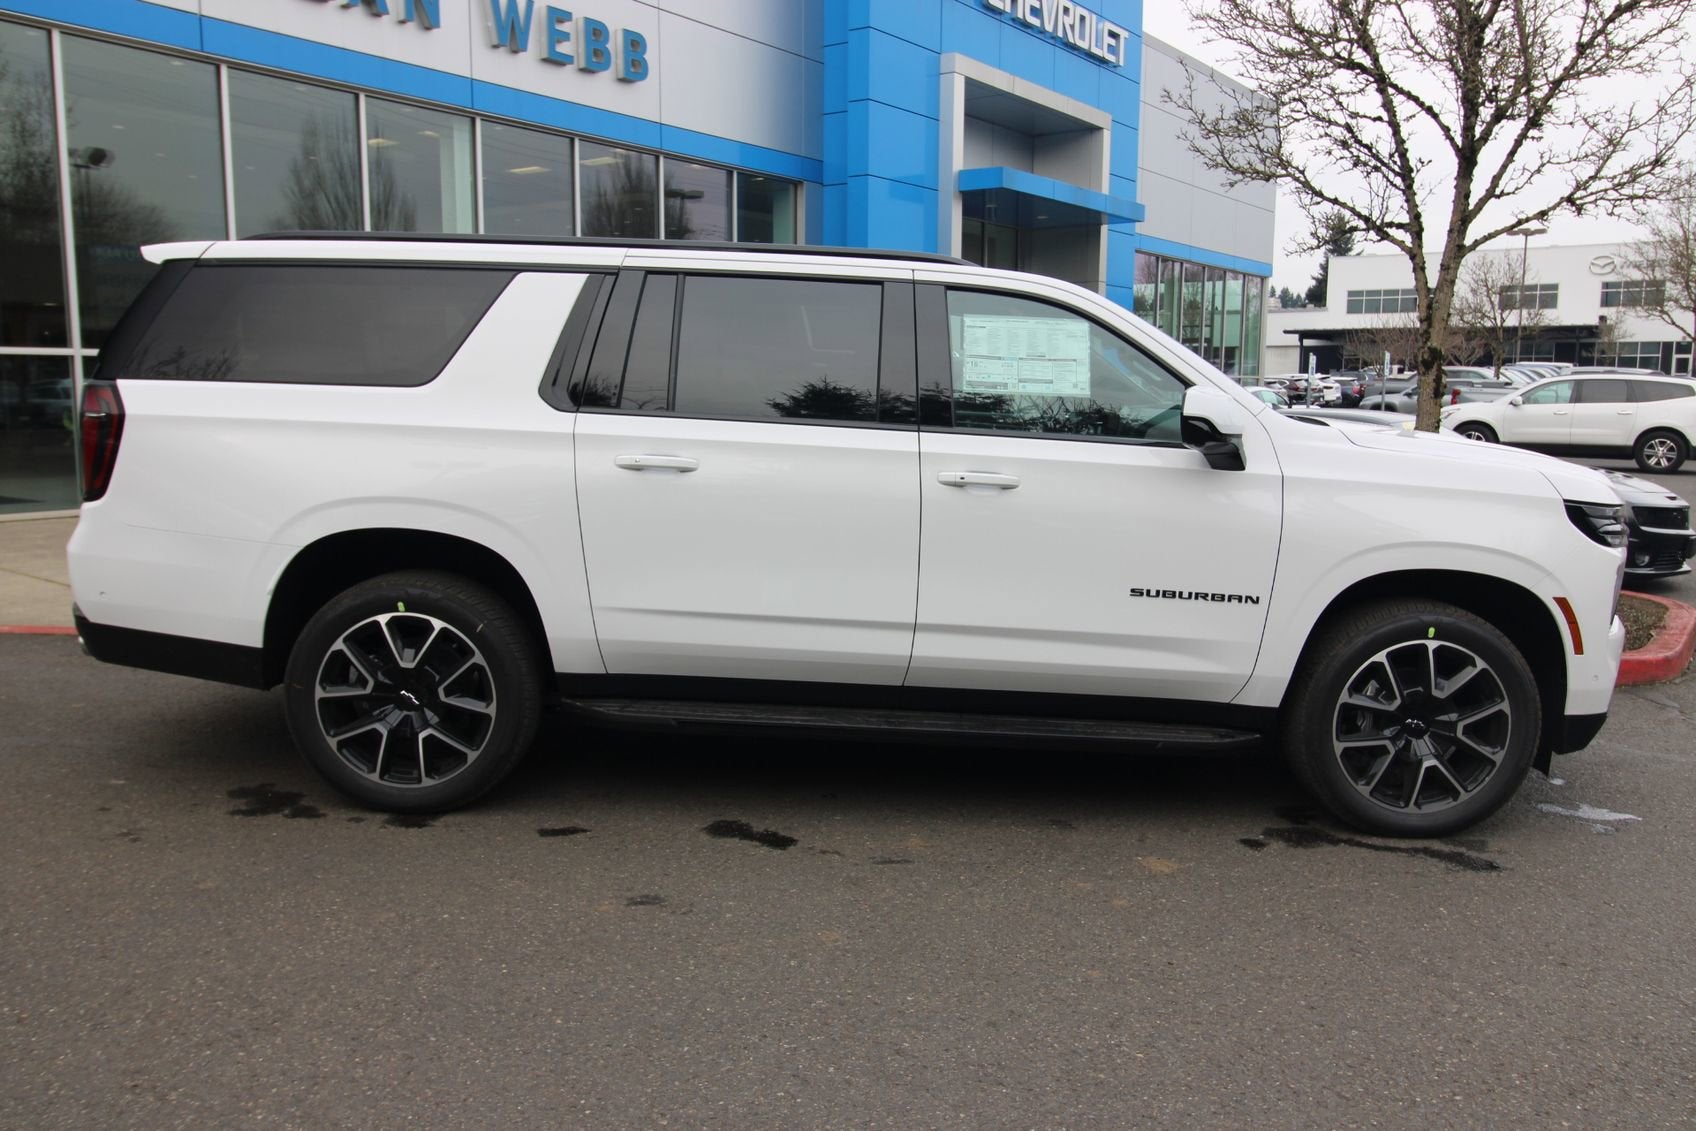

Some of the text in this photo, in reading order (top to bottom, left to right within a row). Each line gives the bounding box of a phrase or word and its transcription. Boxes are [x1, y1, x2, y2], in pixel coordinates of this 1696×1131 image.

[485, 0, 650, 82] WEBB
[984, 0, 1129, 67] EVROLET
[1130, 588, 1260, 605] SUBURBAN
